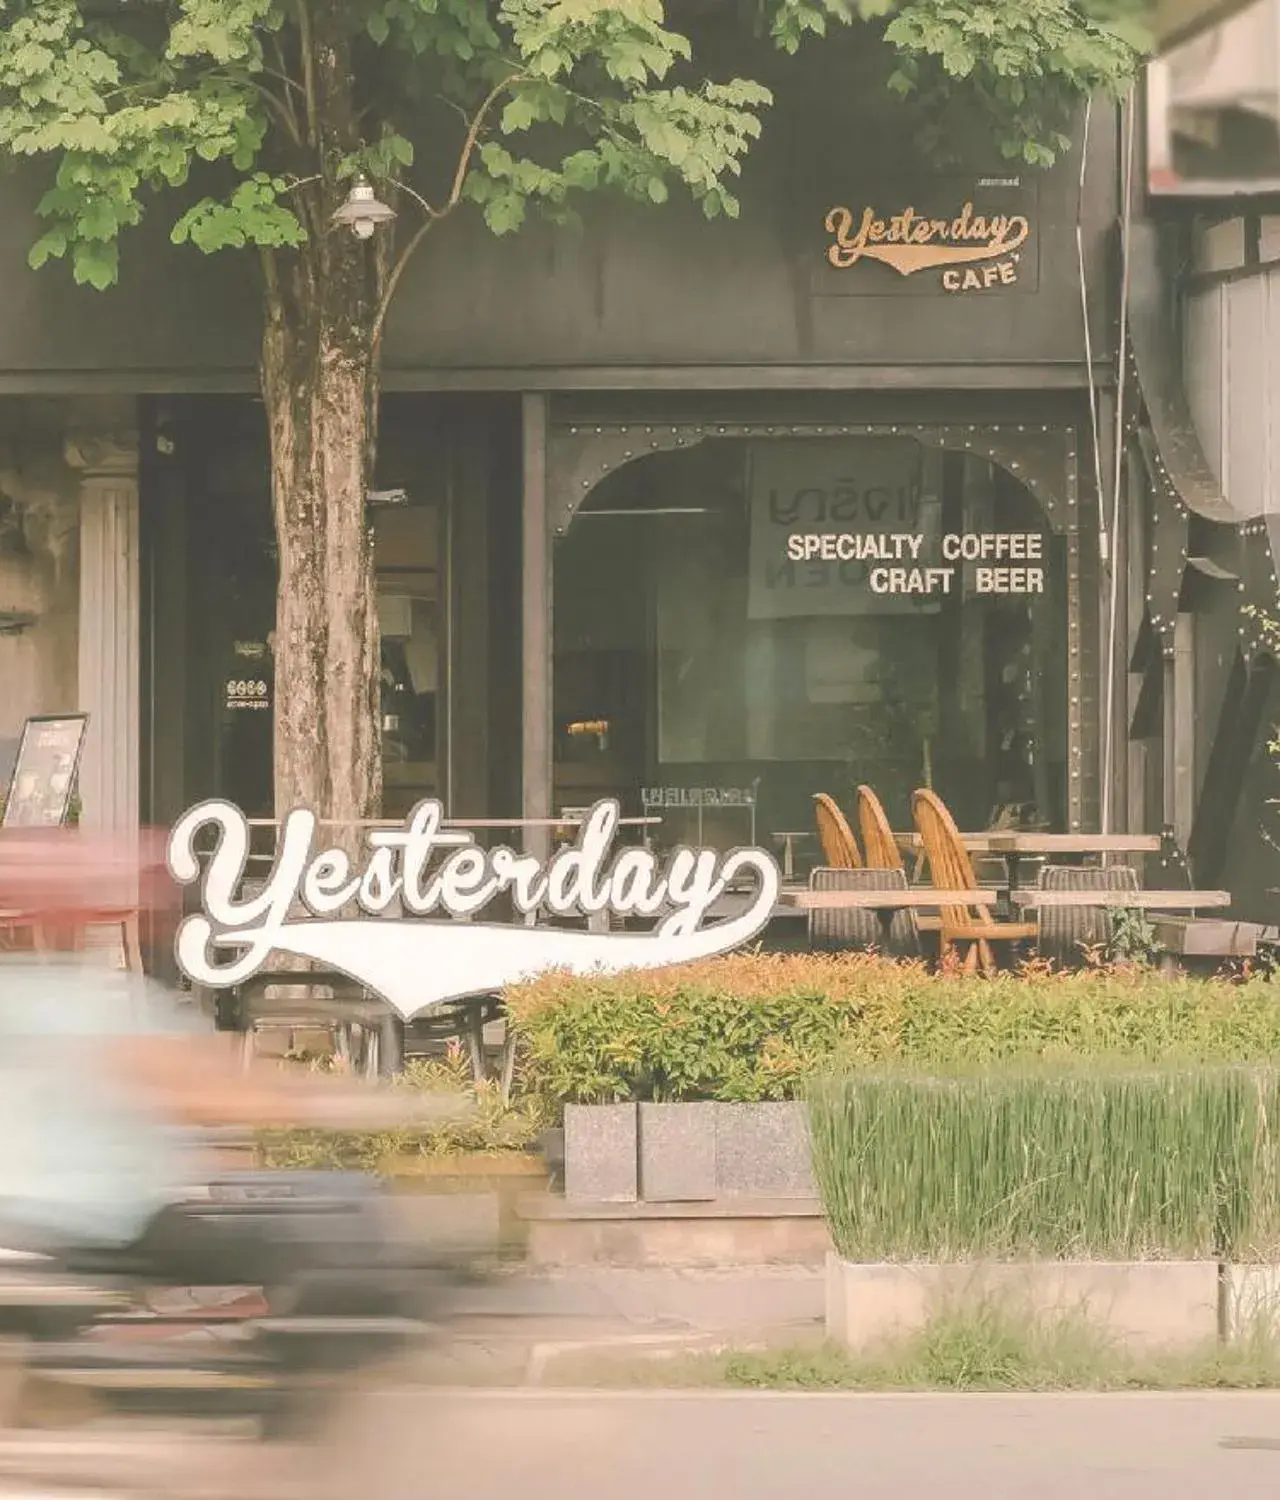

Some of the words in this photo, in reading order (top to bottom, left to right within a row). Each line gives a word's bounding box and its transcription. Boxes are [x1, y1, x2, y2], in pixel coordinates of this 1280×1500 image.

[825, 202, 1028, 268] Yesterday
[787, 533, 924, 560] SPECIALTY
[942, 533, 1042, 560] COFFEE
[870, 567, 955, 593] CRAFT
[976, 567, 1044, 593] BEER
[167, 798, 781, 987] Yesterday
